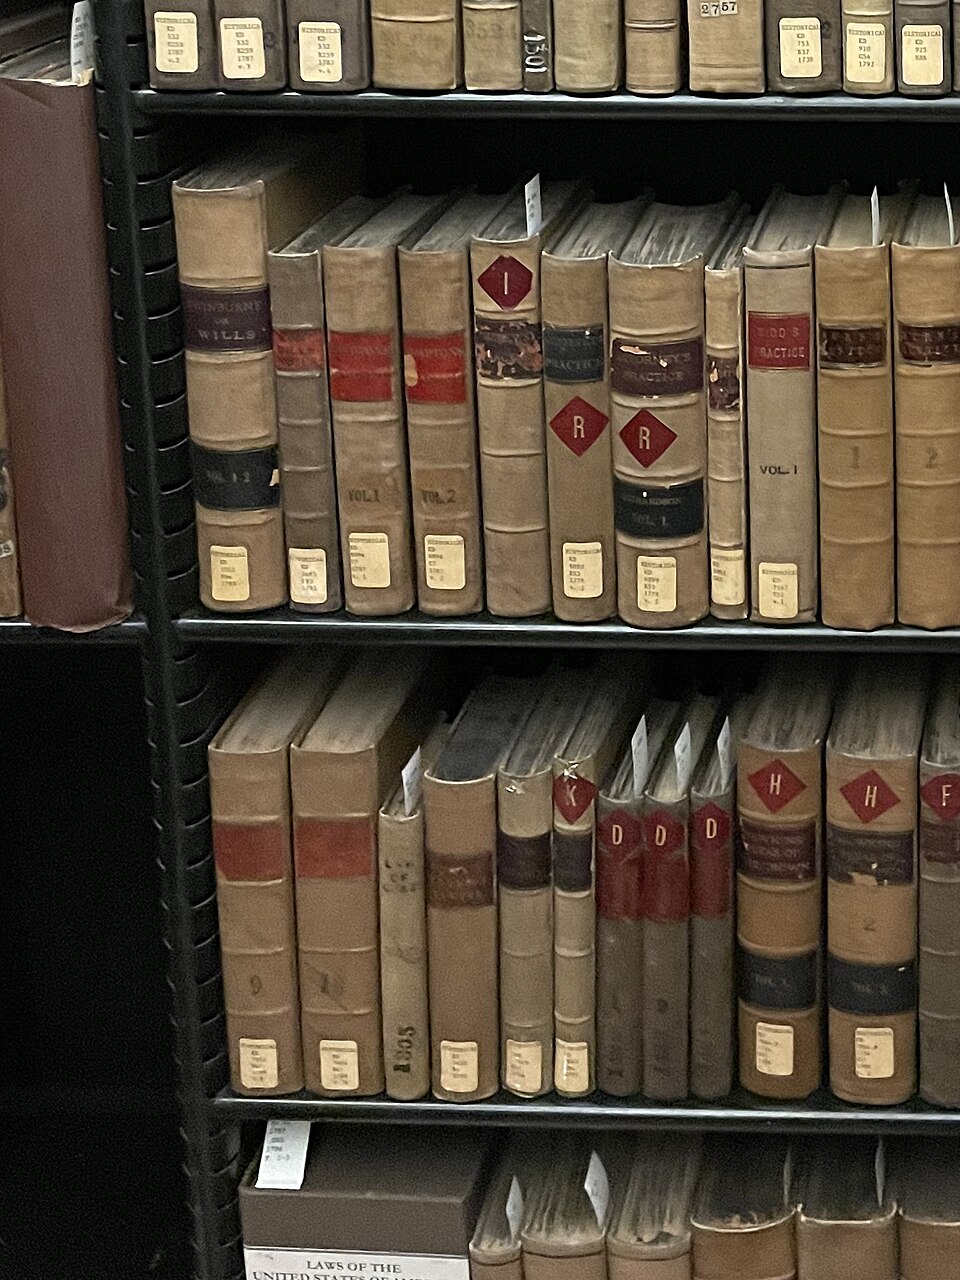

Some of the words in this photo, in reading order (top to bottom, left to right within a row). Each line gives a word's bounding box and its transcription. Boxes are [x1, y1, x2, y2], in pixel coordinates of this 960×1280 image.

[701, 2, 737, 16] 2757
[573, 414, 585, 439] R
[638, 424, 651, 449] R
[770, 774, 782, 795] H
[865, 786, 876, 808] H
[942, 784, 951, 806] F
[612, 825, 623, 845] D
[656, 826, 667, 846] D
[706, 819, 717, 839] D
[253, 1271, 310, 1280] UNITED
[306, 1261, 344, 1271] LAWS
[347, 1262, 366, 1271] OF
[371, 1263, 402, 1273] THE
